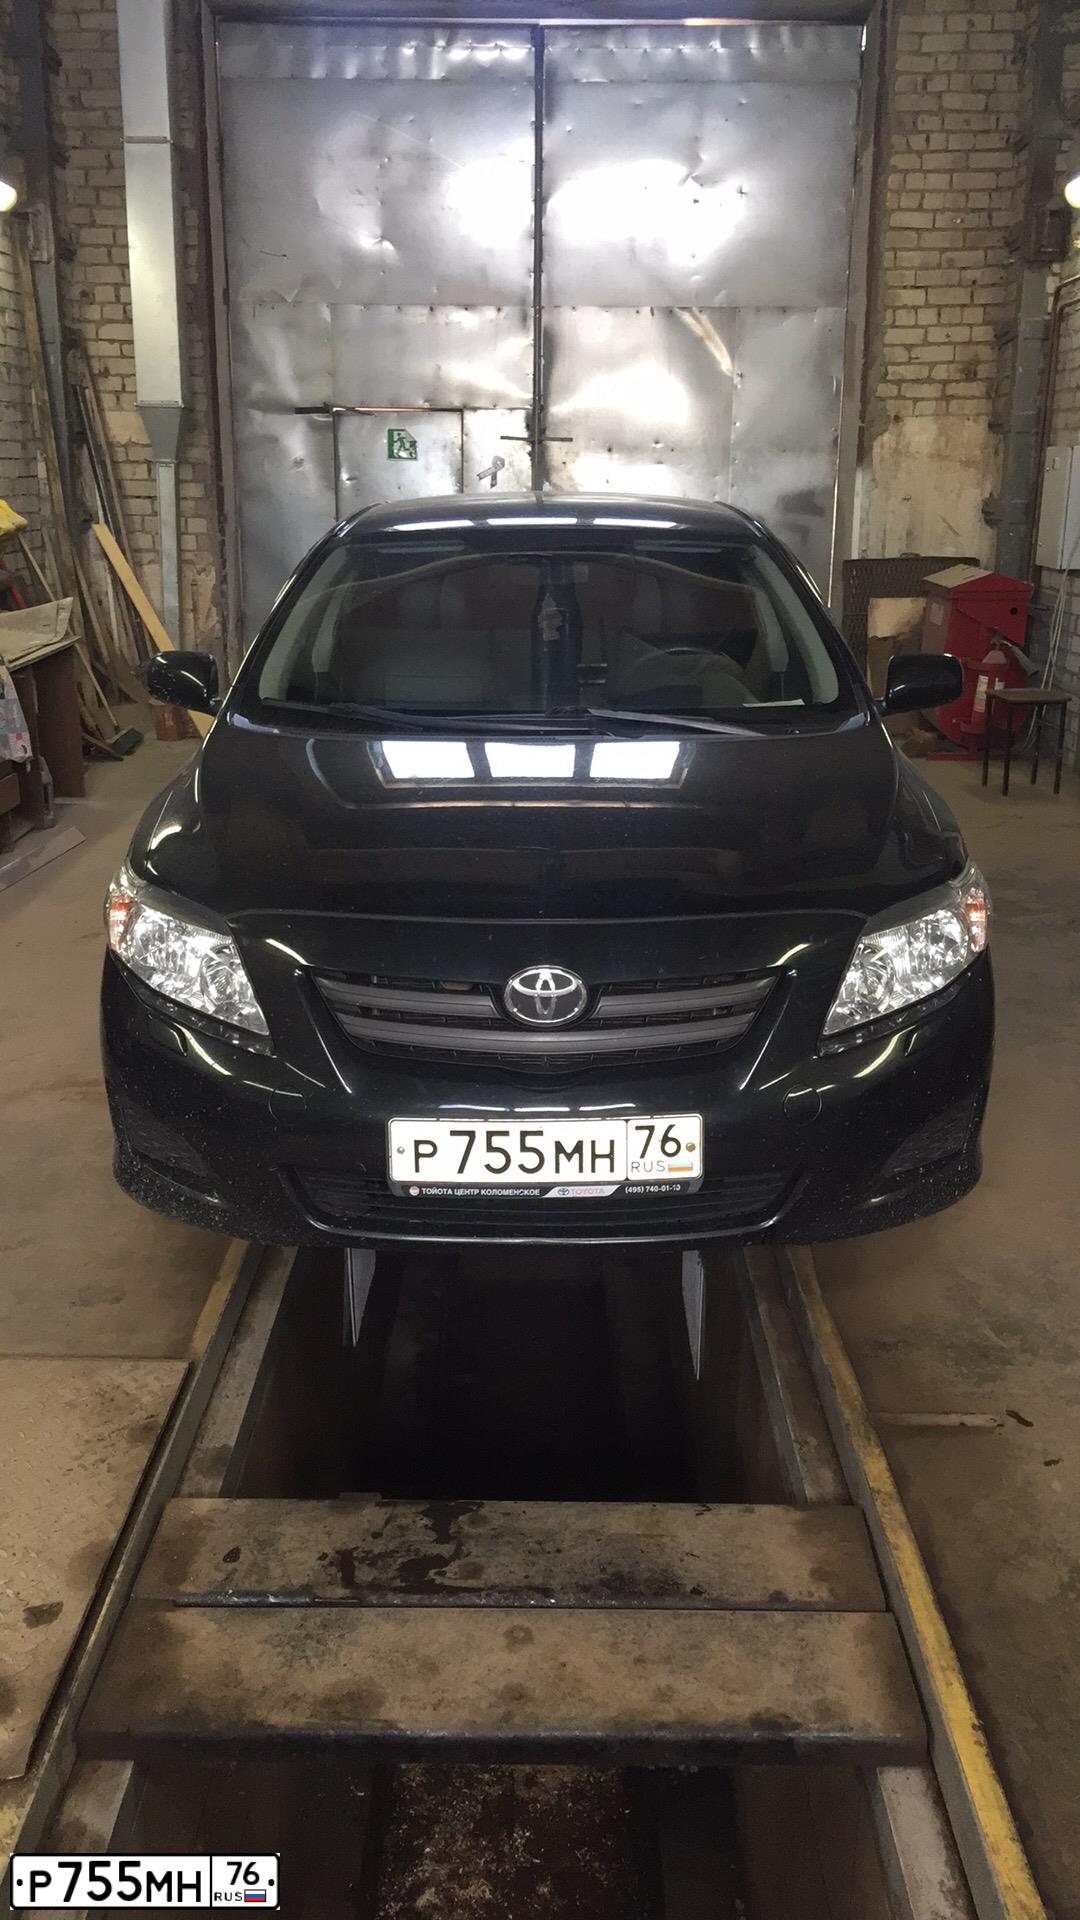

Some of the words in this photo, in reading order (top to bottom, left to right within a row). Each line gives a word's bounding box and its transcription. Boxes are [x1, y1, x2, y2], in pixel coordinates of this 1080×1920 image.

[635, 1124, 682, 1159] 76
[630, 1160, 666, 1173] RUS
[422, 1187, 453, 1195] ТОЙОТА
[454, 1188, 480, 1196] ЦЕНТР
[481, 1188, 540, 1196] КОЛОМЕНСКОЕ
[625, 1185, 645, 1194] (495)
